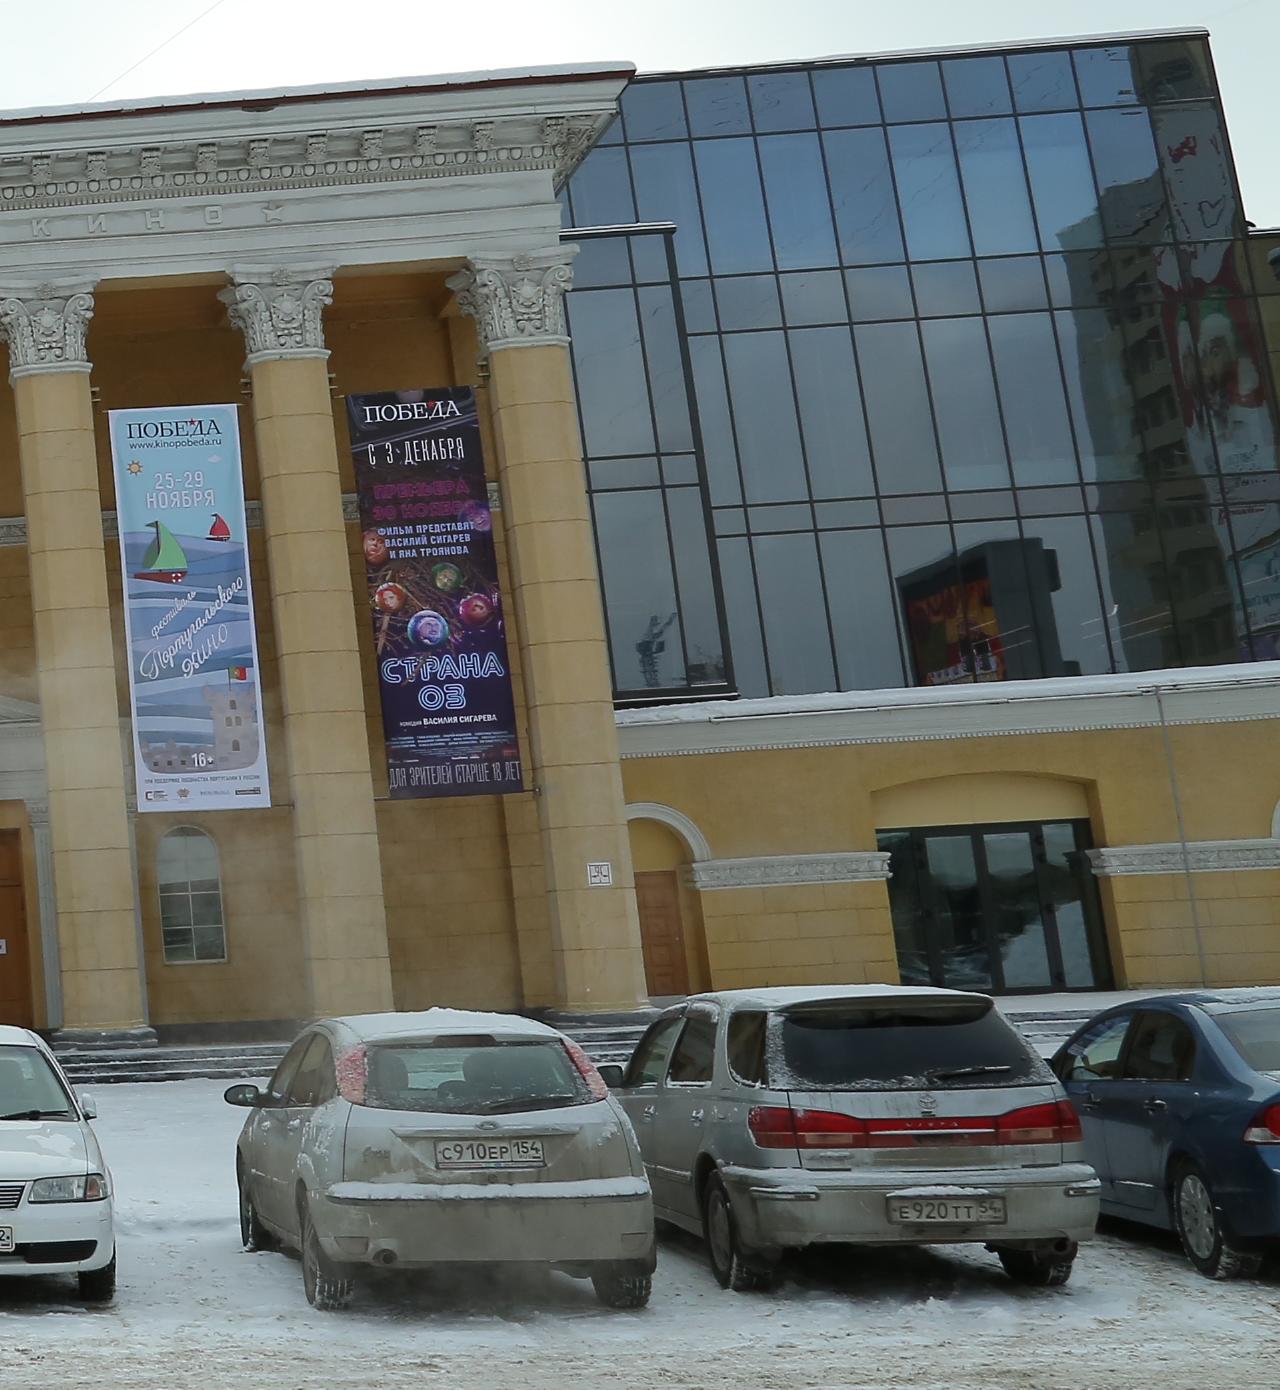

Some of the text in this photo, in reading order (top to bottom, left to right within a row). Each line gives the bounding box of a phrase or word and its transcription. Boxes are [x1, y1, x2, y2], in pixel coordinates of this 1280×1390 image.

[363, 400, 462, 423] ПОБЕДА
[126, 418, 222, 439] ПОБЕДА
[129, 437, 222, 450] www.kinopobeda.ru
[367, 437, 465, 465] С 3 ДЕКАБРЯ
[154, 471, 205, 489] 25-29
[146, 489, 215, 510] НОЯБРЯ
[377, 520, 475, 536] ФИЛЬМ ПРЕДСТАВЯТ
[384, 532, 471, 548] ВАСИЛИЙ СИГАРЕВ
[389, 545, 470, 559] И ЯНА ТРОЯНОВА
[381, 651, 505, 683] СТРАНА
[423, 716, 458, 726] ВАСИЛИЯ
[459, 714, 498, 723] СИГАРЕВА
[191, 752, 214, 768] 16+
[388, 768, 407, 790] ДЛЯ
[409, 762, 453, 786] ЗРИТЕЛЕЙ
[455, 763, 491, 783] СТАРШЕ
[505, 761, 521, 780] ЛЕТ
